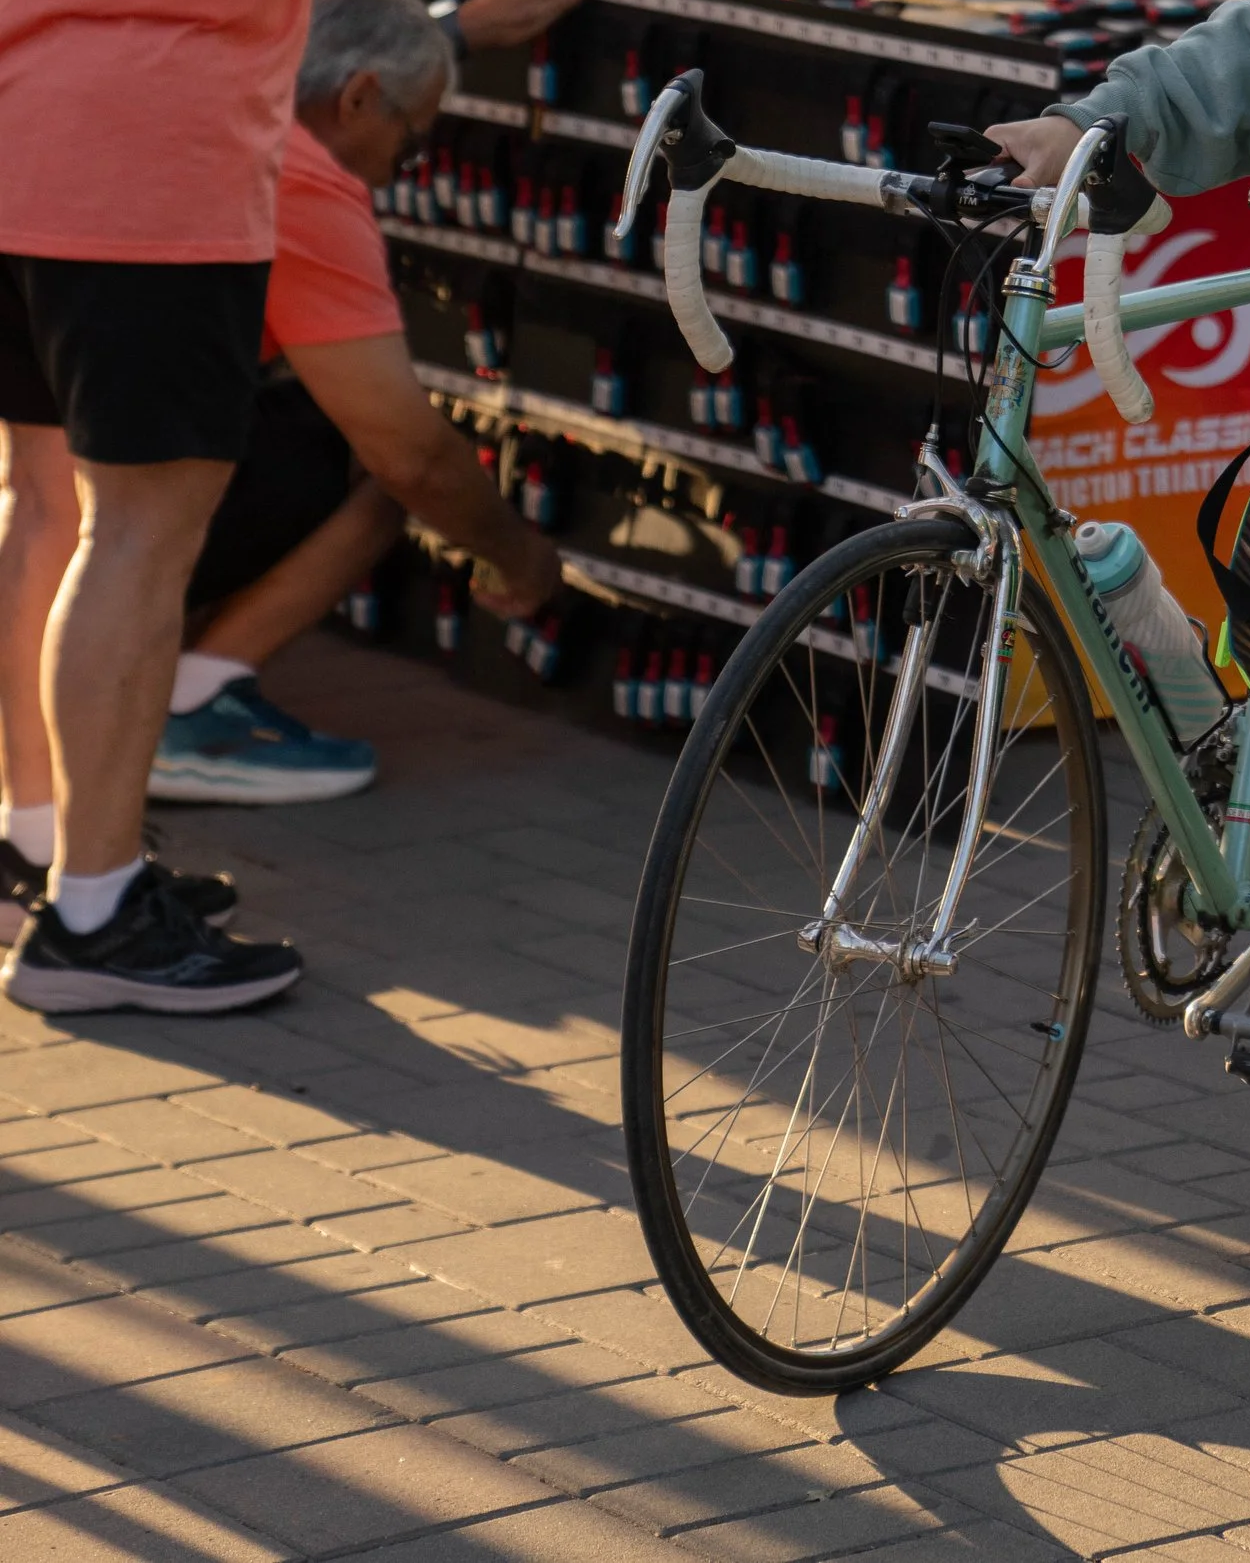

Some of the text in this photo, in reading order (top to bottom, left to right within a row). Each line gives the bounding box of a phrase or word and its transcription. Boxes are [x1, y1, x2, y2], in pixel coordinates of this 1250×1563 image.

[959, 196, 978, 206] ITM
[1029, 428, 1117, 472] EACH
[1048, 467, 1133, 512] TICTON
